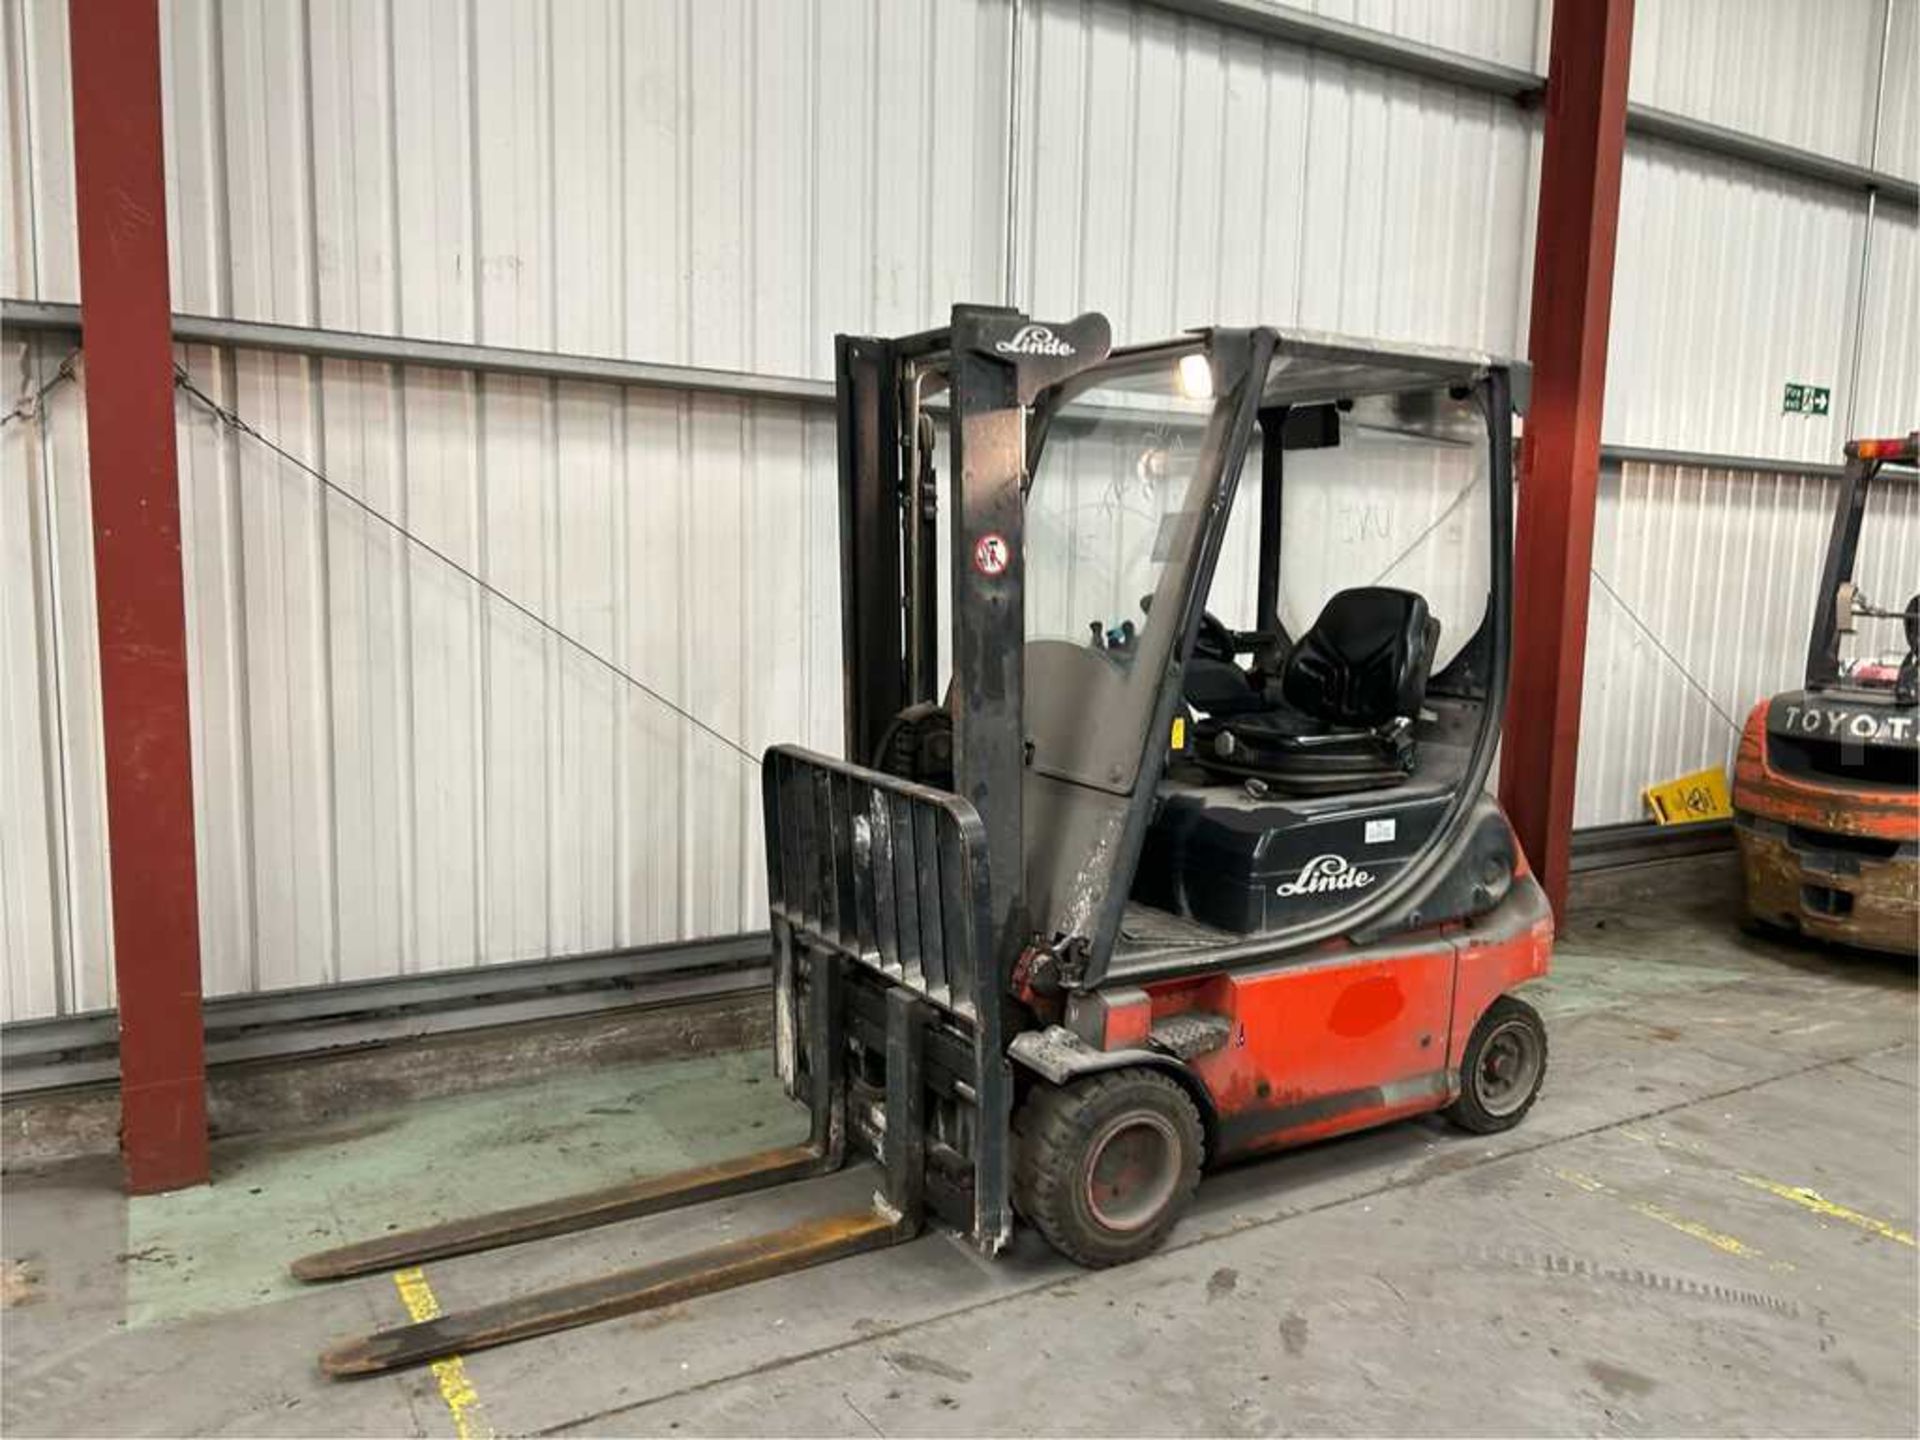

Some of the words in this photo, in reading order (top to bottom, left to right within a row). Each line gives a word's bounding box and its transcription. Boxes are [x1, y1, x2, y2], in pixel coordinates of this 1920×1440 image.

[995, 325, 1076, 356] Linde
[1786, 706, 1919, 741] TOYOT
[1276, 854, 1375, 897] Linde
